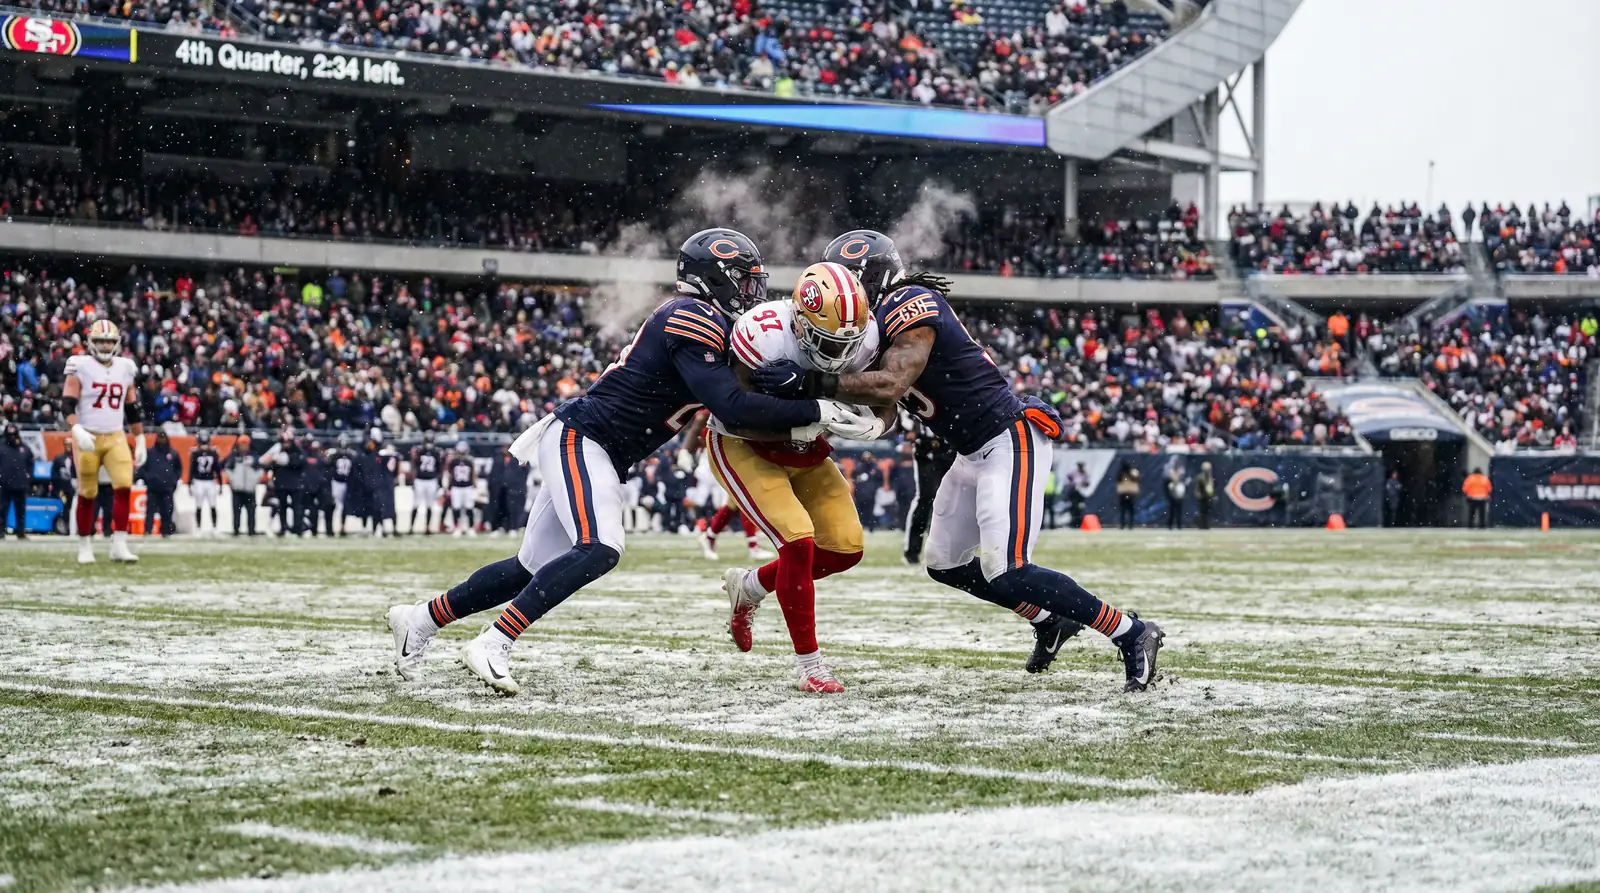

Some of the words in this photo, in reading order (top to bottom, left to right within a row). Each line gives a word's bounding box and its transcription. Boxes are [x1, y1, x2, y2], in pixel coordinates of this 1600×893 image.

[175, 39, 213, 66] 4th
[218, 43, 308, 80] Quarter,
[312, 53, 360, 81] 2:34
[363, 58, 405, 85] left.
[753, 309, 783, 332] 97
[899, 299, 927, 322] GSH
[91, 382, 123, 409] 78
